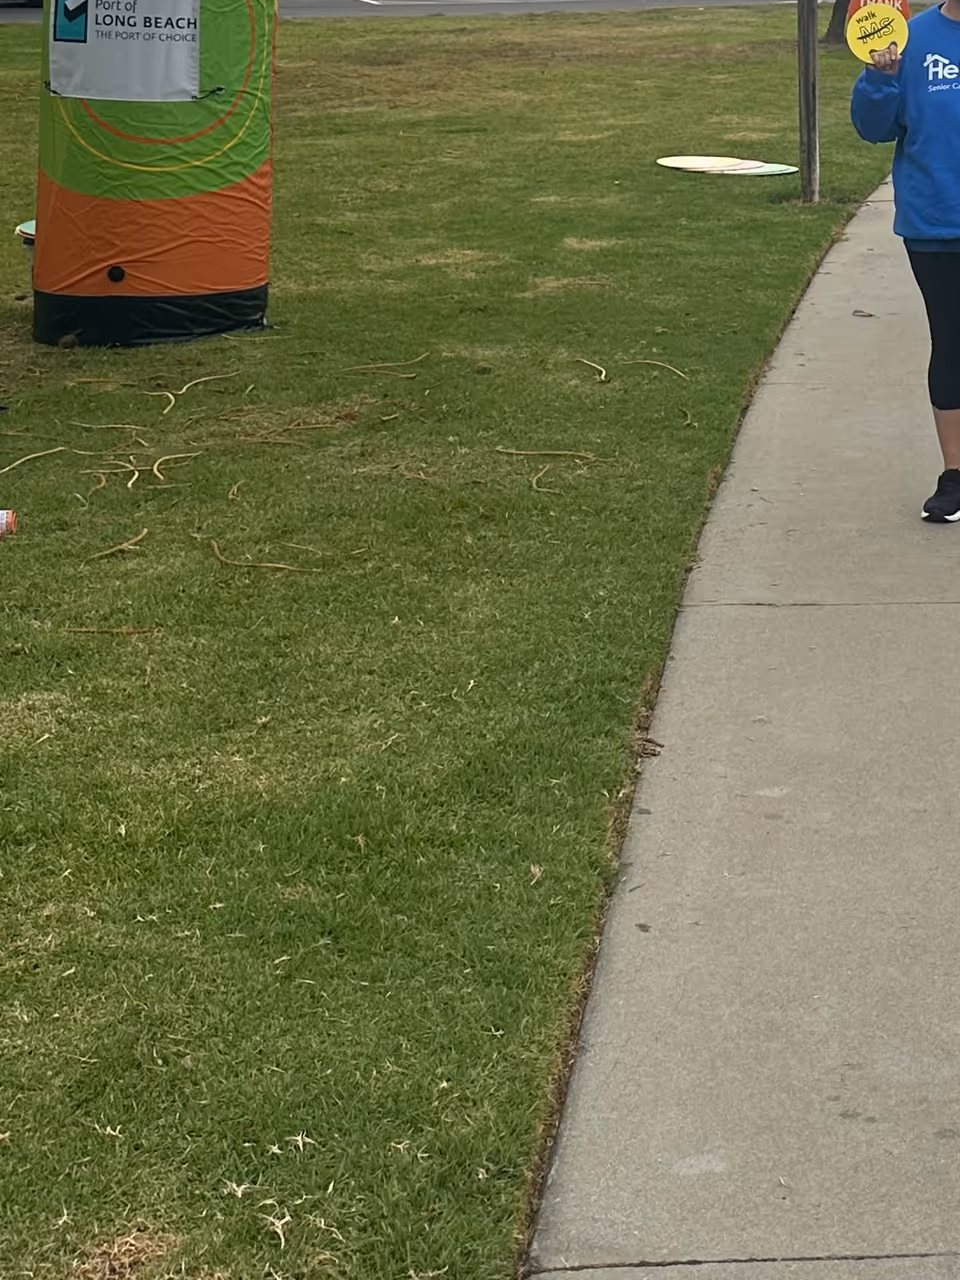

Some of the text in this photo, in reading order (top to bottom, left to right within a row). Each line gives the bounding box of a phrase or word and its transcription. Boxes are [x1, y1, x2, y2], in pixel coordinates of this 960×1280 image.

[124, 0, 138, 13] of
[95, 13, 198, 30] LONG BEACH
[855, 10, 877, 25] walk
[95, 29, 198, 43] THE PORT OF CHOICE
[858, 16, 895, 45] MS
[927, 84, 951, 93] Senior
